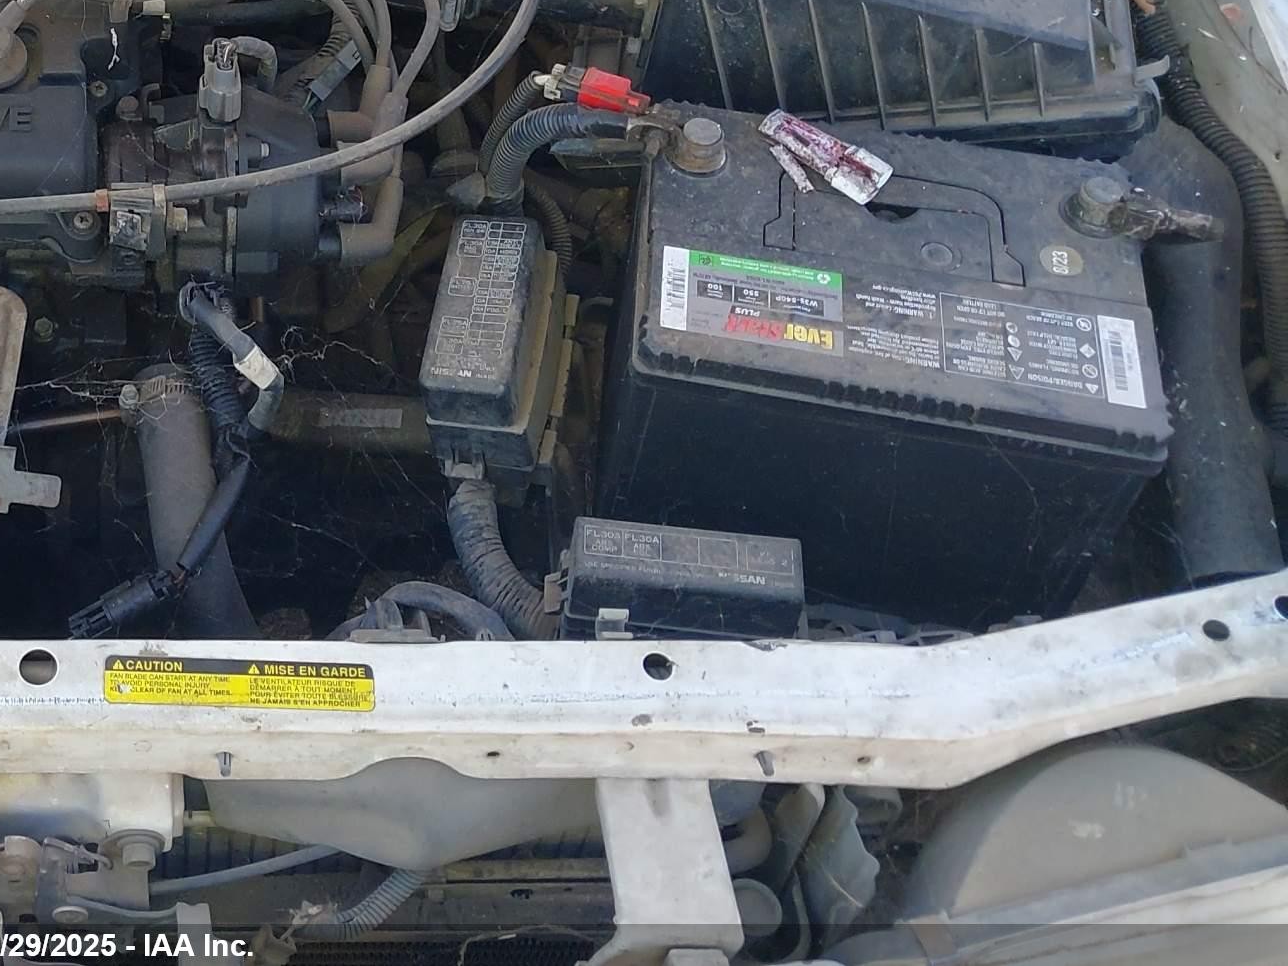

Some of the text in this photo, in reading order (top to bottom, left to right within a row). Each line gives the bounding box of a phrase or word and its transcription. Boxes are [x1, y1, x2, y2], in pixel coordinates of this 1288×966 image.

[734, 307, 760, 317] PLUS
[723, 314, 833, 349] EverStart
[125, 660, 183, 671] CAUTION
[264, 664, 366, 678] MISE EN GARDE
[260, 678, 312, 686] VENTILATEUR
[314, 679, 342, 687] RISQUE
